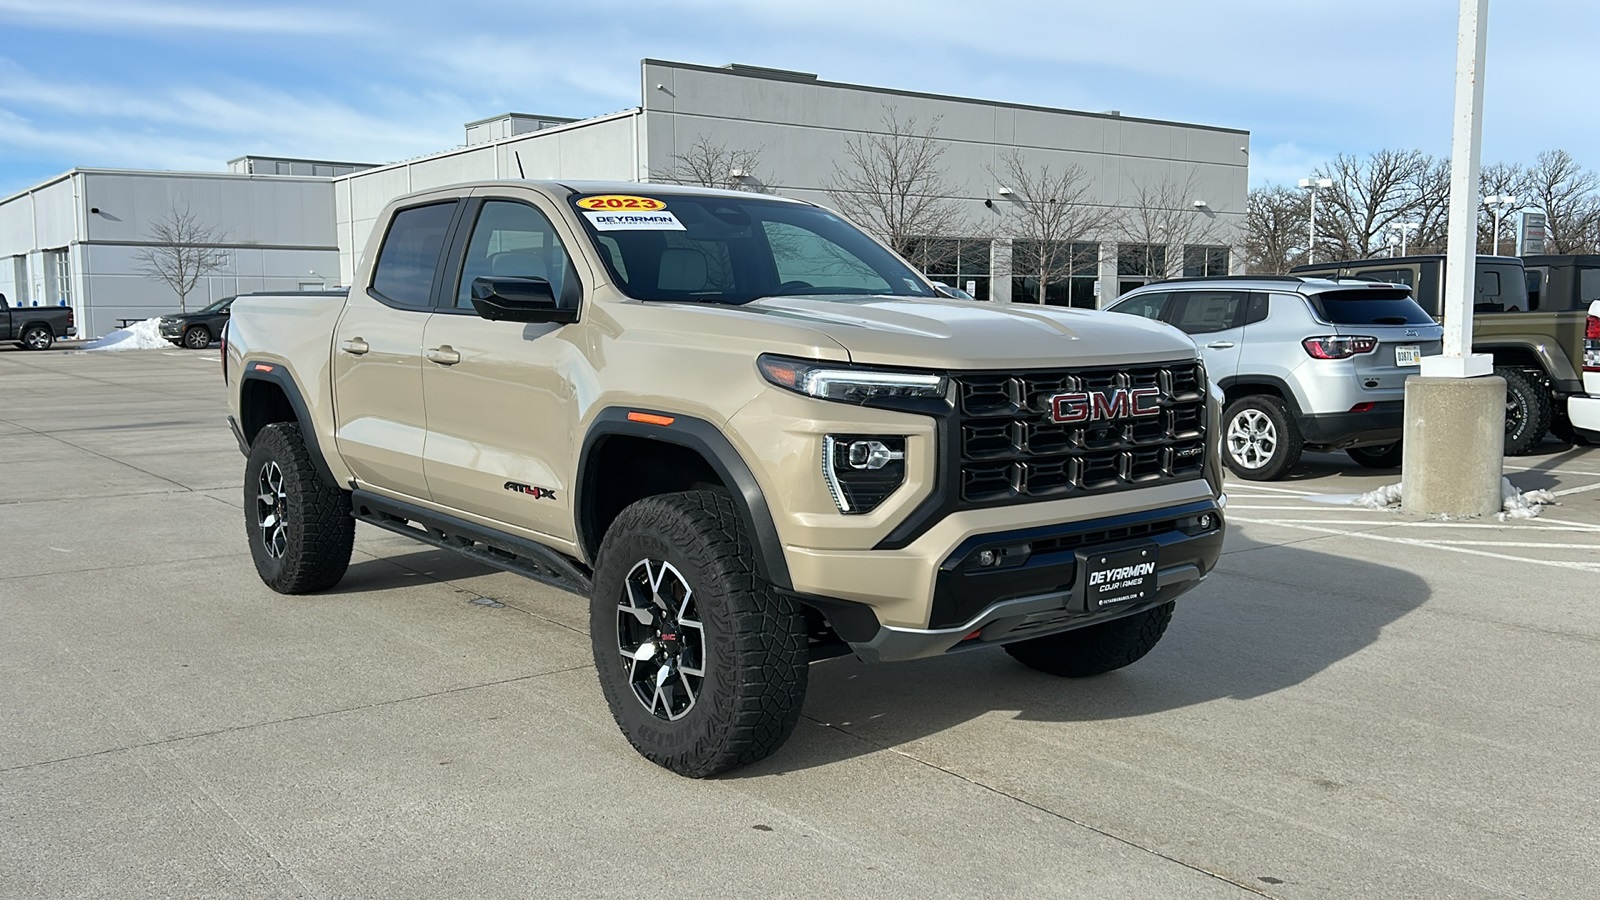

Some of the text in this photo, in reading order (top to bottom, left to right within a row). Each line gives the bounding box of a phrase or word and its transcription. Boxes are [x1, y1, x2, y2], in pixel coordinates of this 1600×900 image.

[589, 199, 659, 208] 2023
[1052, 387, 1160, 423] GMC
[503, 481, 557, 500] AT4X
[1089, 562, 1155, 585] DEYARMAN
[1099, 578, 1143, 592] CDJR AMES
[661, 633, 676, 641] GMC
